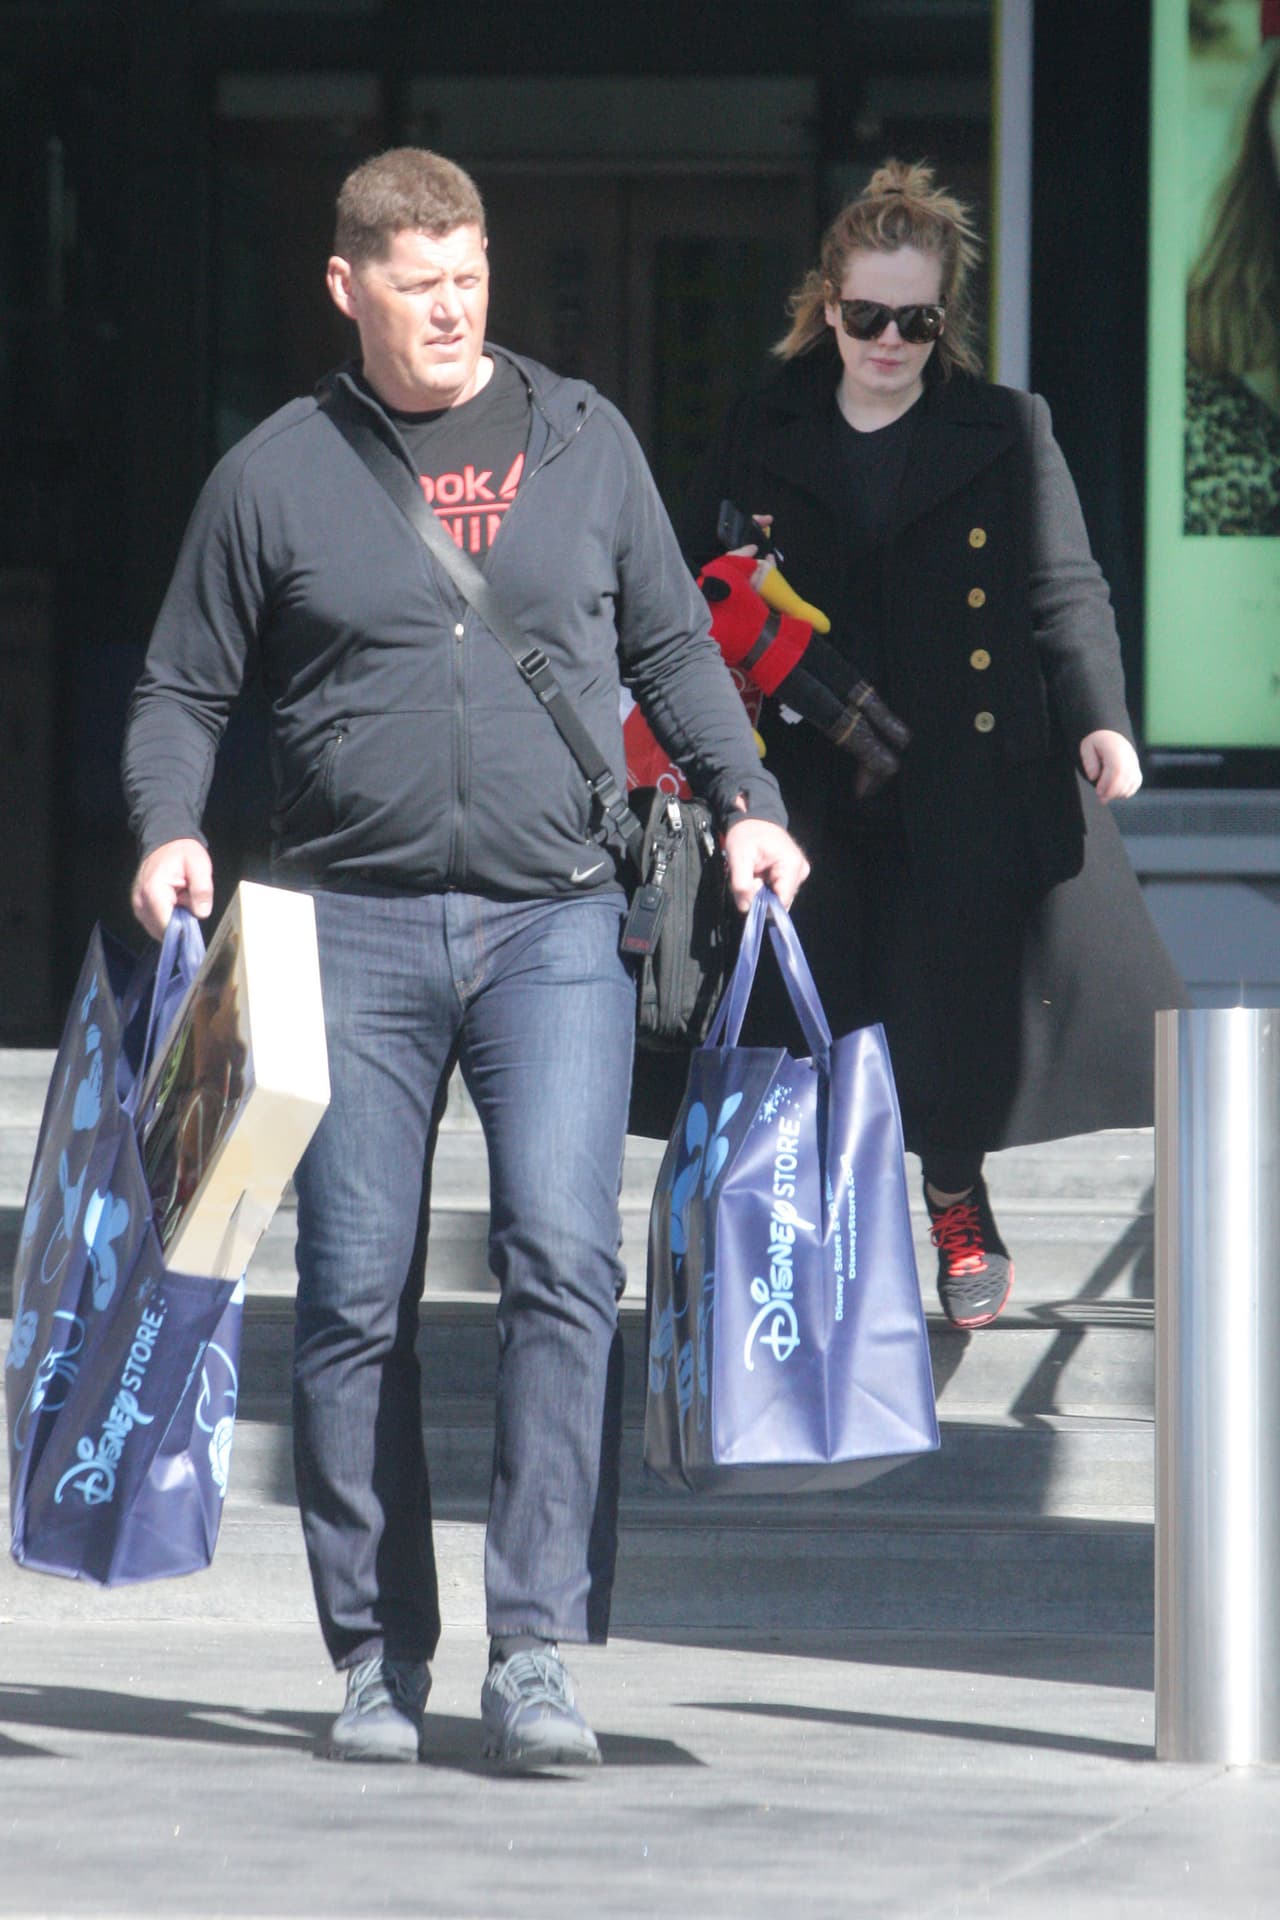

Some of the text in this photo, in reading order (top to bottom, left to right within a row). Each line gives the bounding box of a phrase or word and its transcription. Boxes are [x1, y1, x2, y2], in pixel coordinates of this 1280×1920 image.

[772, 1115, 802, 1199] STORE
[834, 1233, 843, 1272] Store
[834, 1274, 845, 1321] Disney
[120, 1306, 163, 1393] STORE
